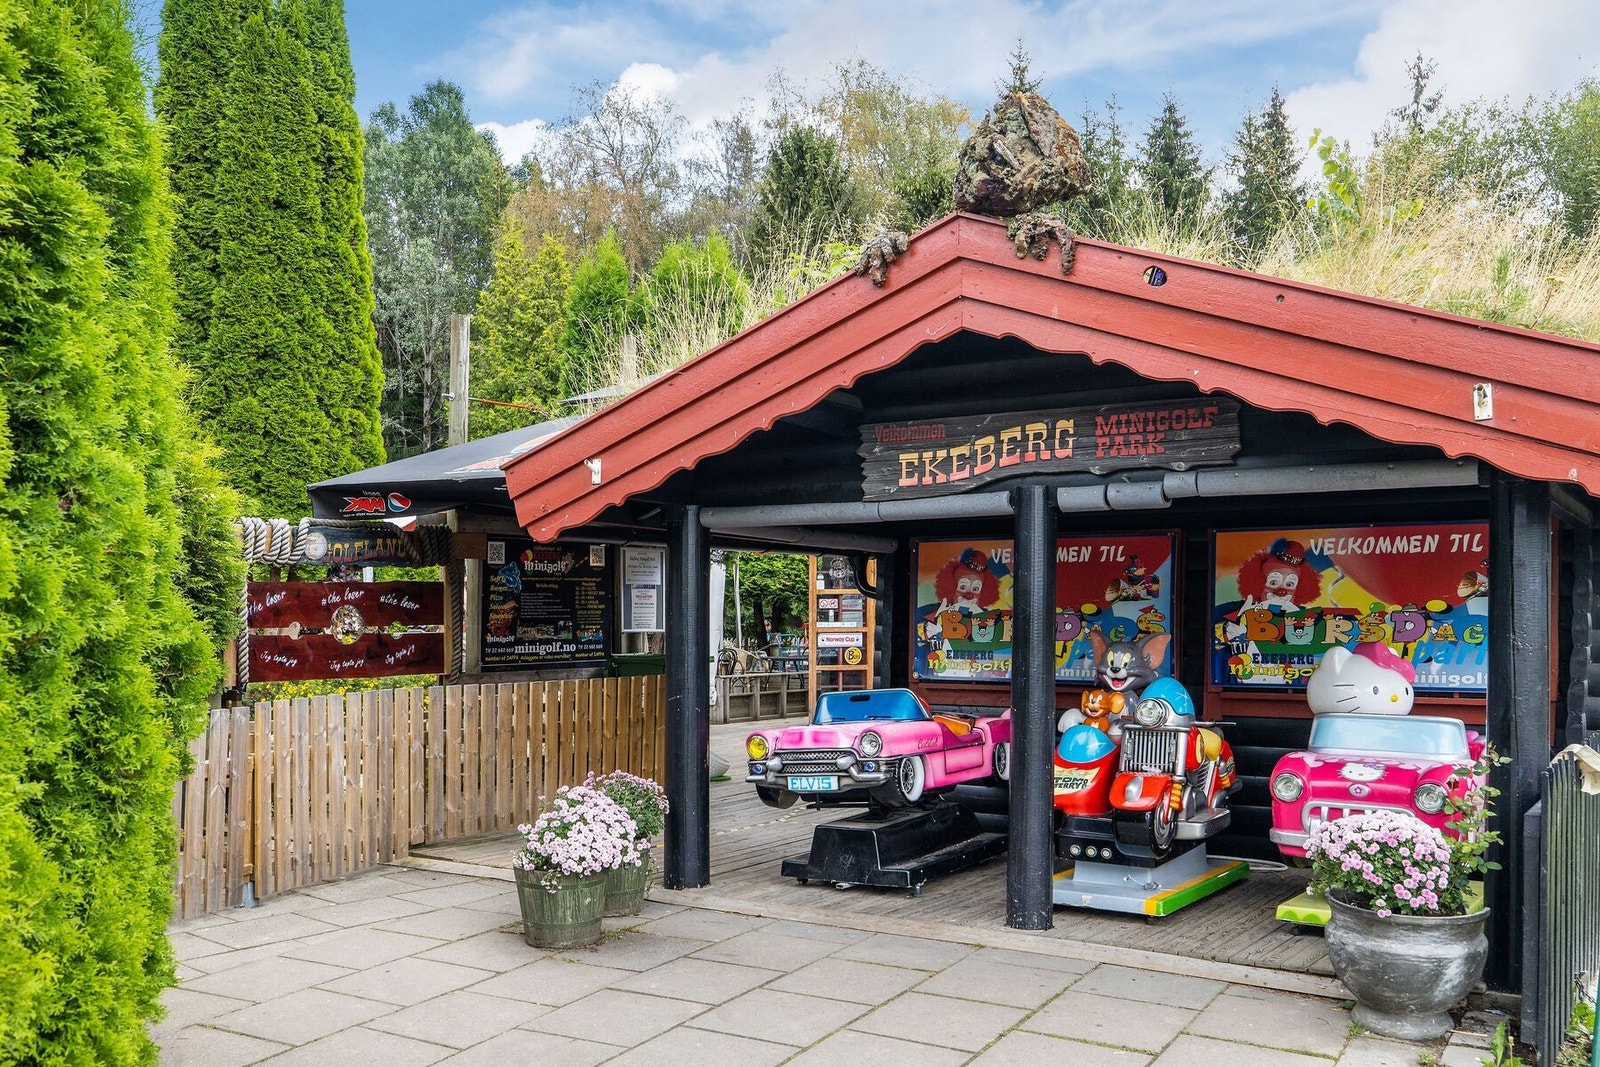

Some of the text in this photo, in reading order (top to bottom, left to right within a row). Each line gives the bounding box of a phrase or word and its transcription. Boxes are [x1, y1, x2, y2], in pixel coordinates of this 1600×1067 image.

[1095, 406, 1219, 436] MINIGOLF
[874, 423, 946, 442] Velkommen
[898, 418, 1078, 487] EKEBERG
[1095, 432, 1167, 458] PARK
[1310, 533, 1484, 556] VELKOMMEN TIL
[1100, 545, 1126, 563] TIL
[344, 587, 365, 599] loser
[400, 595, 420, 610] loser
[514, 642, 576, 656] minigolf.no
[1252, 653, 1314, 665] EKEBERG
[791, 777, 832, 790] ELVIS
